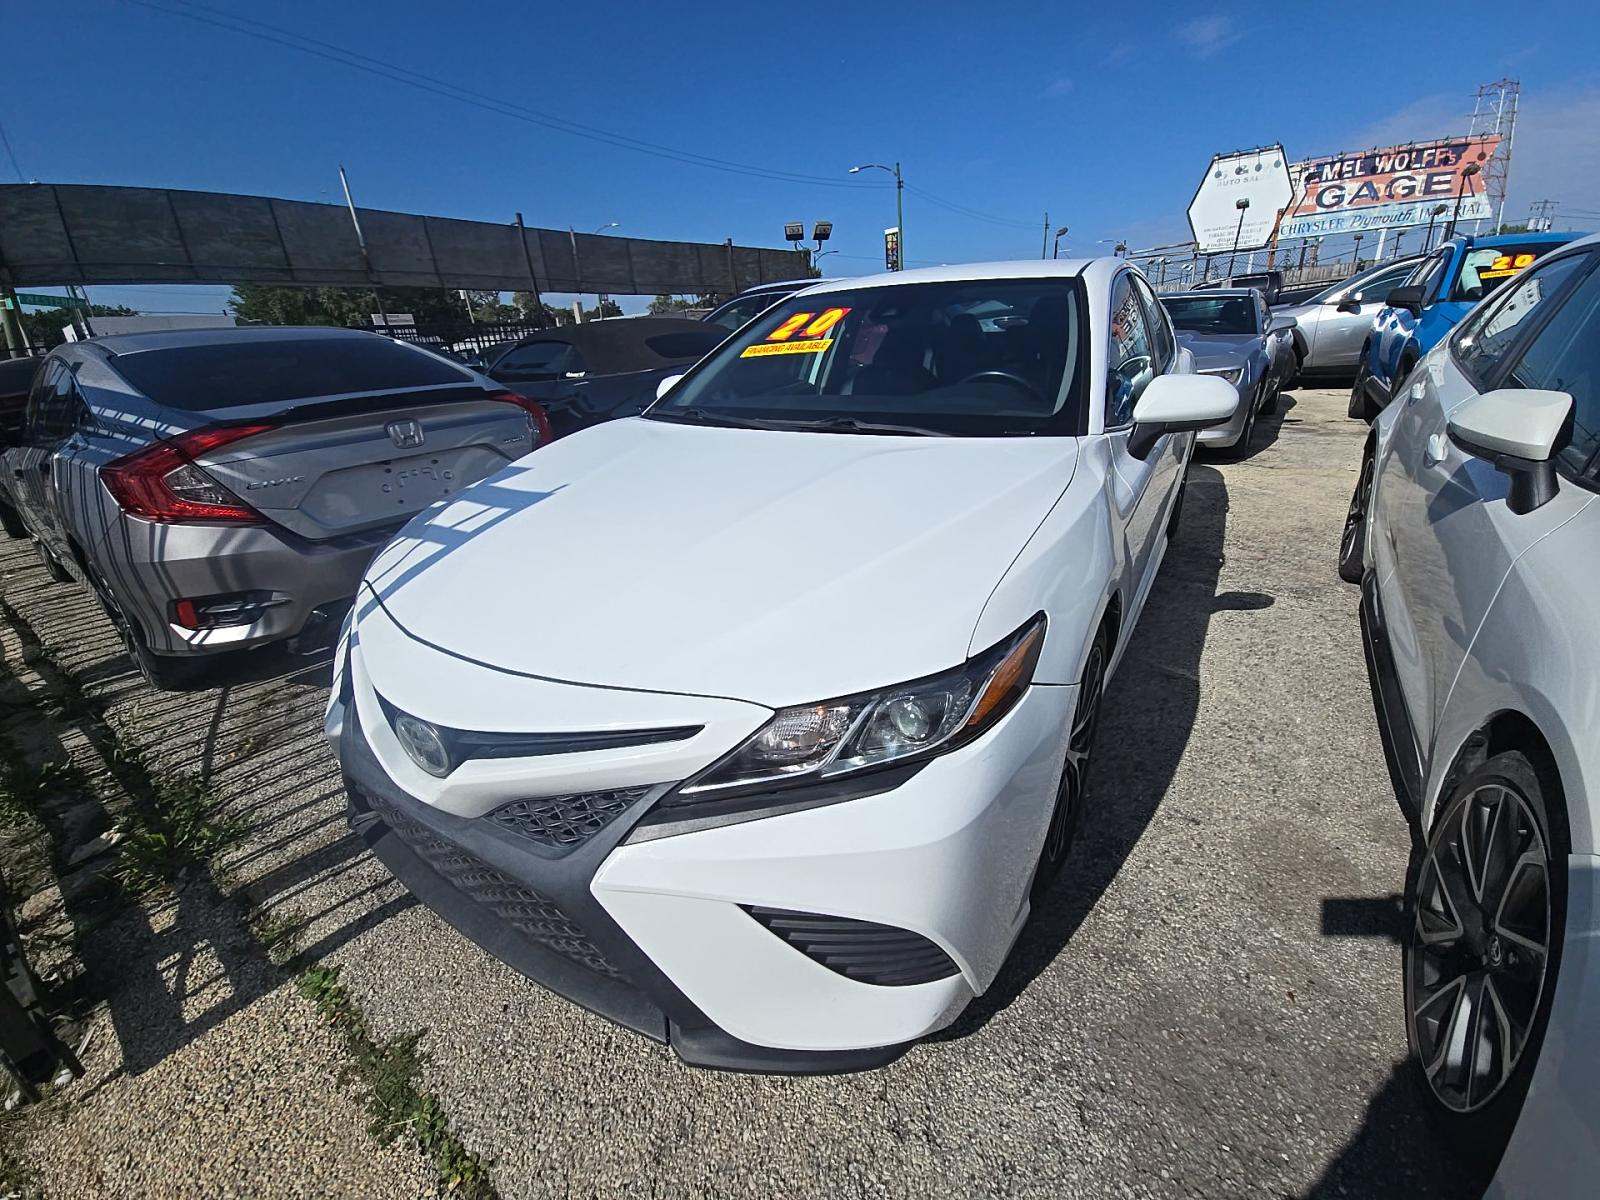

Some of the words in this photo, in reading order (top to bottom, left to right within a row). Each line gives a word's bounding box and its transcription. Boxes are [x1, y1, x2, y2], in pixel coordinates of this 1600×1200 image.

[1322, 159, 1366, 181] MEL
[1315, 170, 1457, 208] GAGE
[1280, 217, 1345, 236] CHRYSLER
[1350, 208, 1414, 228] Plymouth
[1491, 254, 1536, 270] 20
[766, 307, 850, 340] 20
[784, 340, 829, 352] AVAILABLE
